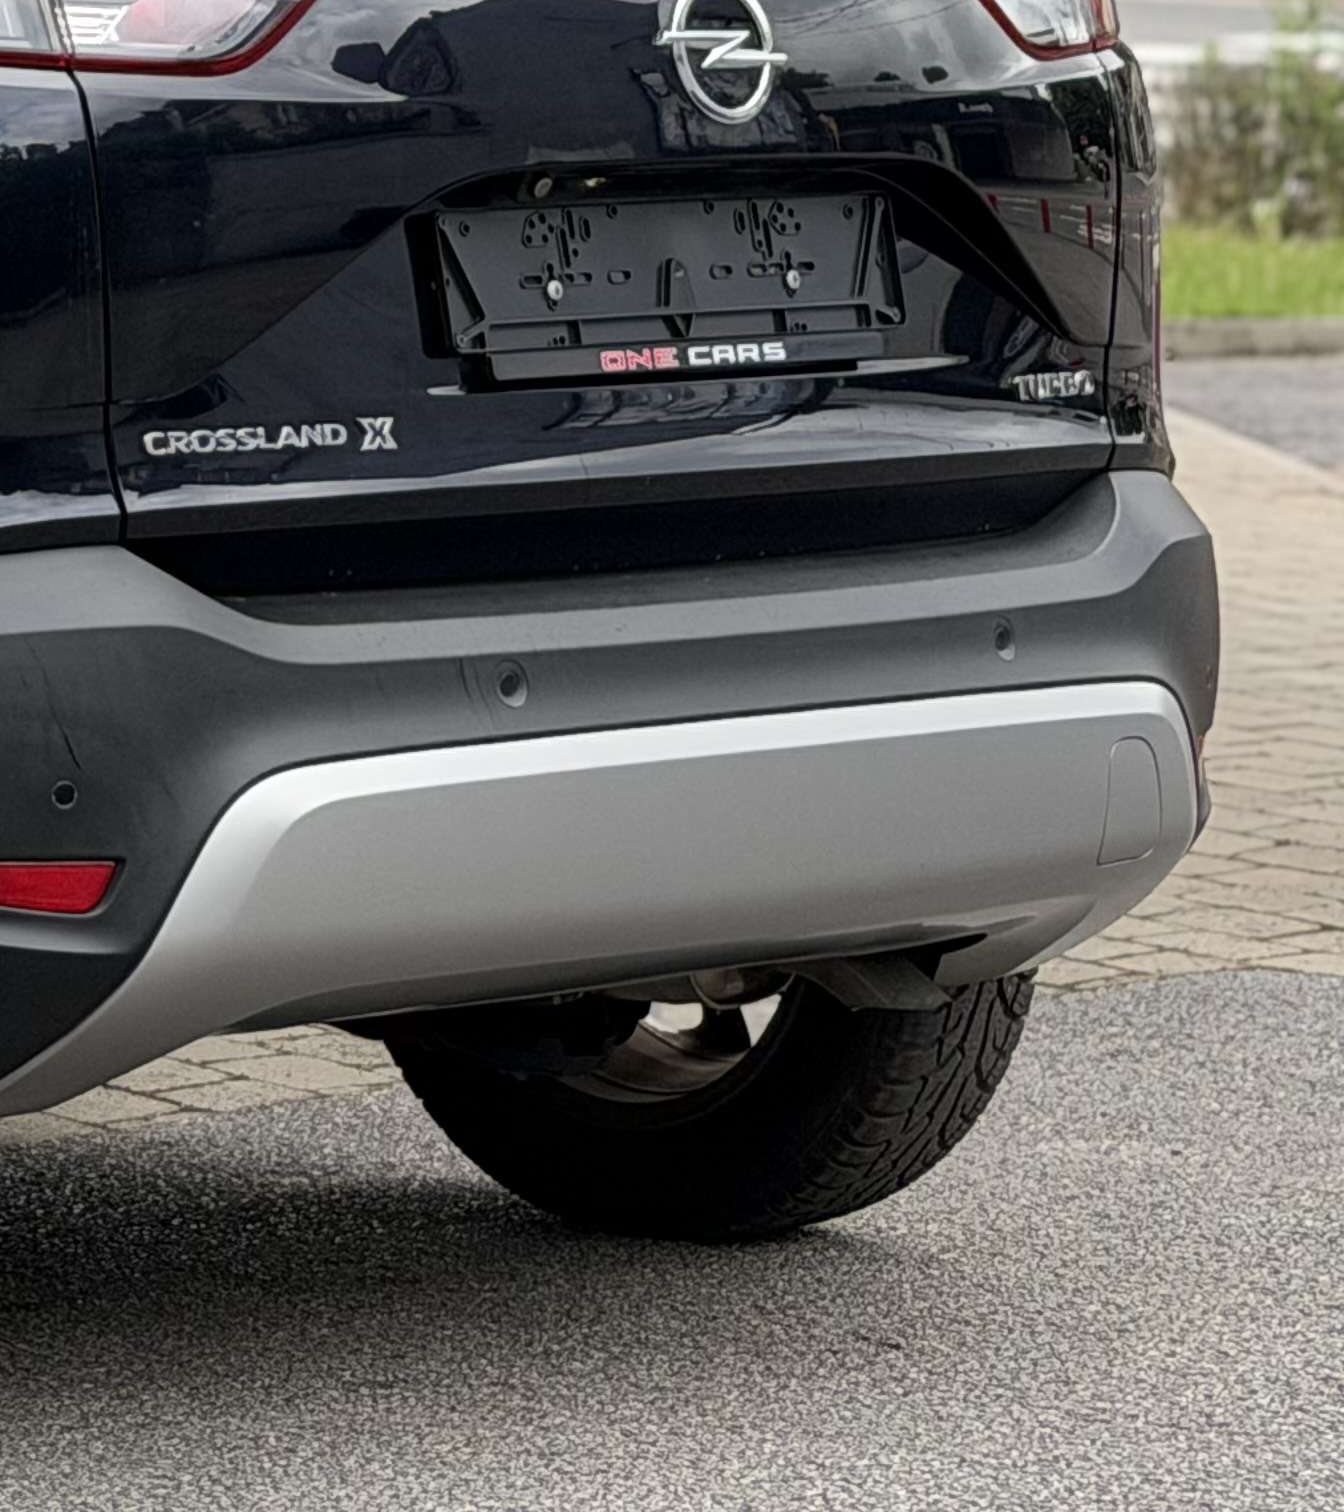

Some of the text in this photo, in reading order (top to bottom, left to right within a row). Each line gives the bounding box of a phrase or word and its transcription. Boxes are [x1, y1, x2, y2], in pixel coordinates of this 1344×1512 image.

[600, 341, 787, 372] ONE CARS
[143, 416, 398, 455] CROSSLAND X
